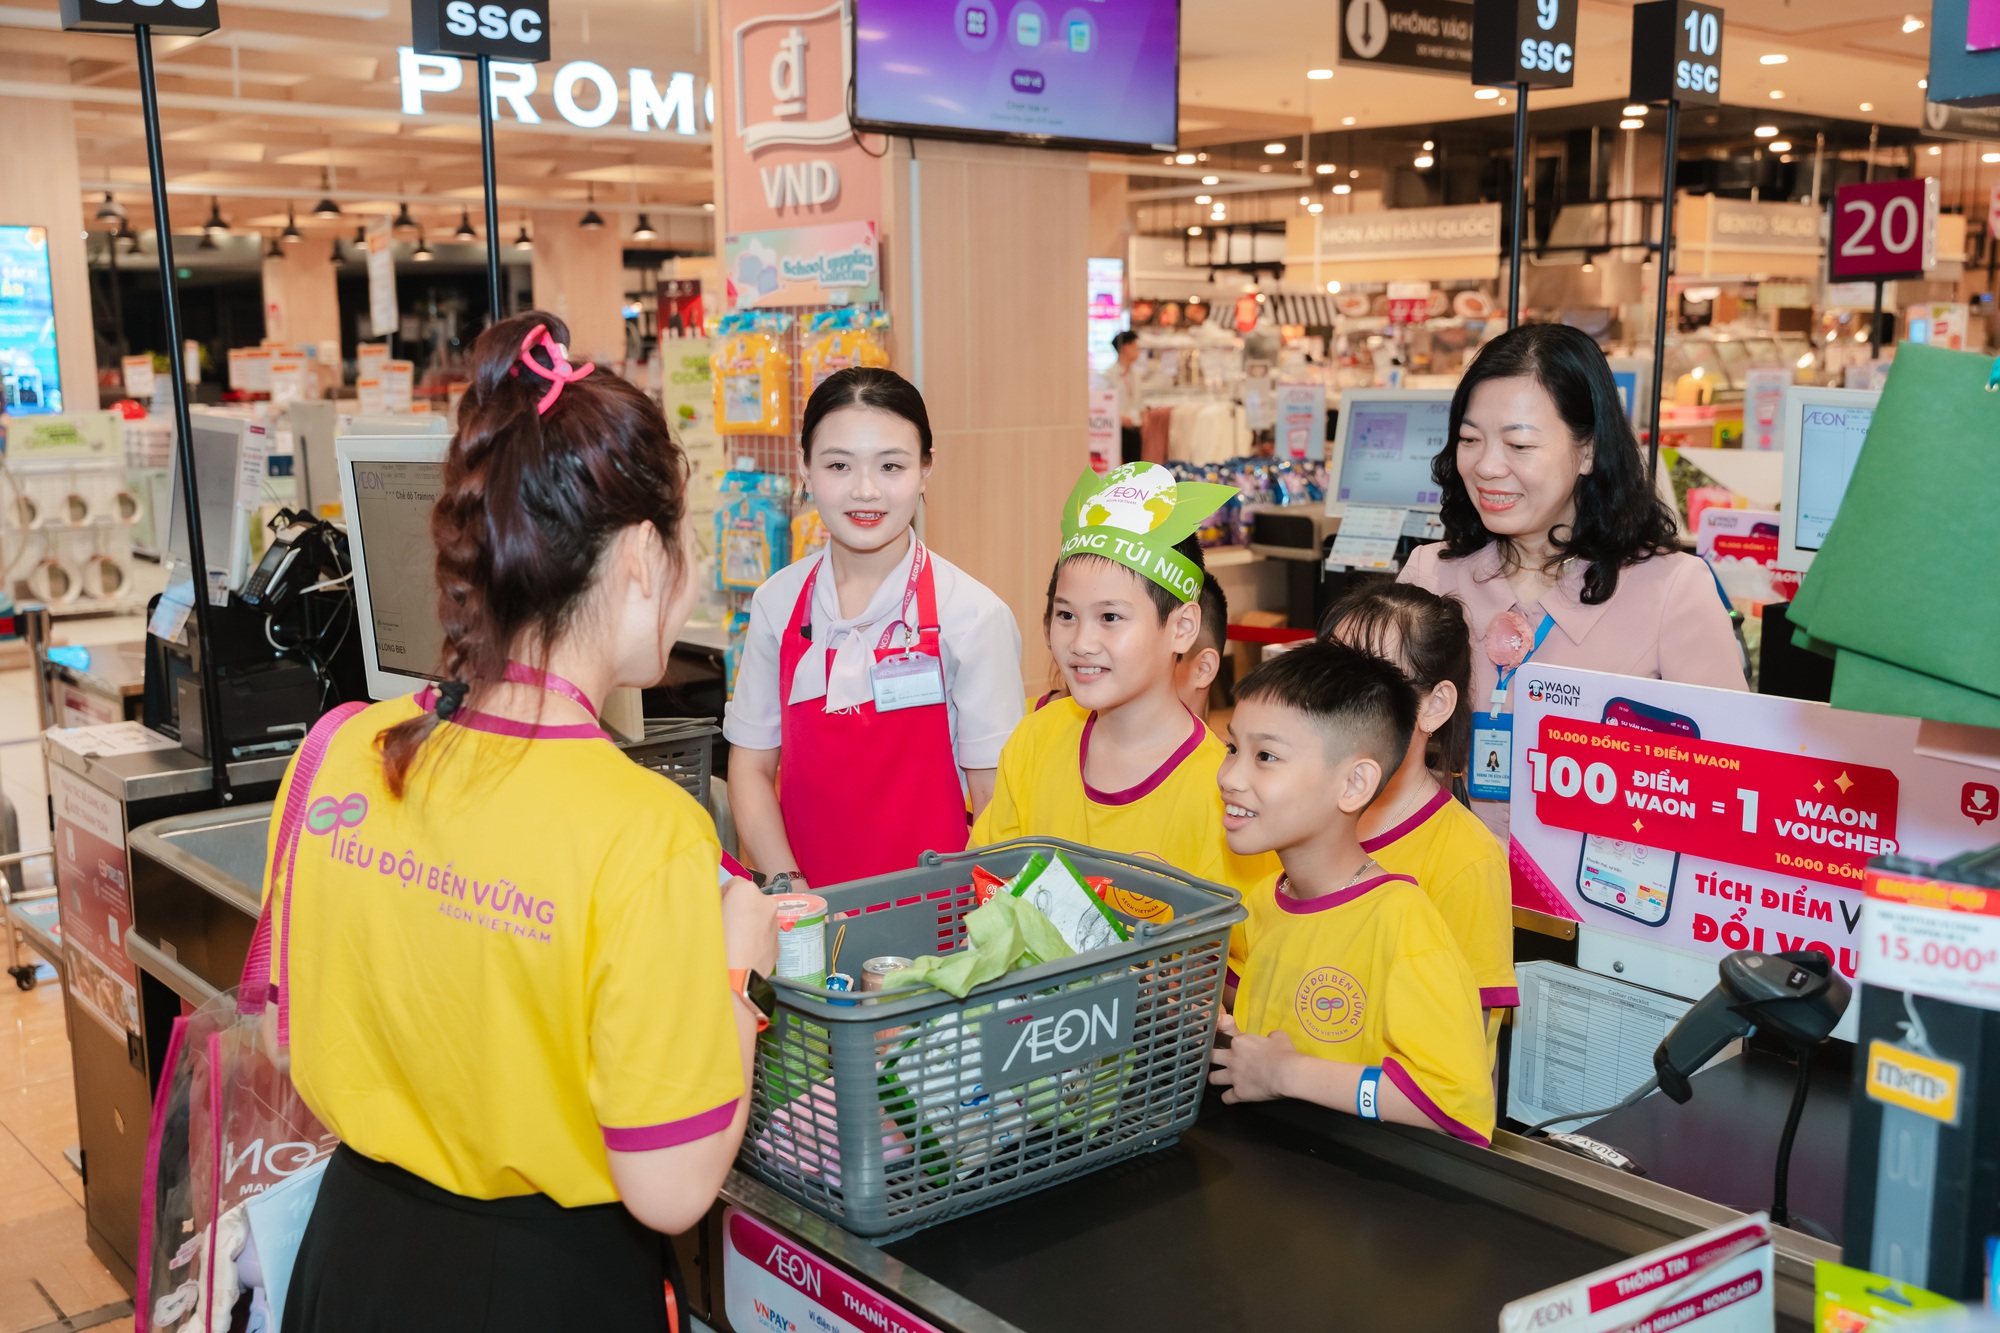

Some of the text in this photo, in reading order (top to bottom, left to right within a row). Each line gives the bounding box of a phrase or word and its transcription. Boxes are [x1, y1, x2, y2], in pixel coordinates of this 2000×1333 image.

[446, 1, 542, 43] SSC
[1684, 11, 1718, 55] 10
[1520, 38, 1572, 73] SSC
[398, 46, 714, 135] PROM
[1676, 60, 1720, 94] SSC
[760, 160, 841, 208] VND
[1841, 196, 1919, 256] 20
[414, 492, 435, 503] Training
[1061, 533, 1108, 555] HÔNG
[1114, 538, 1151, 566] TÚI
[382, 643, 395, 652] LONG
[1545, 681, 1580, 696] WAON
[1545, 693, 1580, 707] POINT
[1548, 728, 1588, 744] 10.000
[1591, 735, 1630, 752] ĐỒNG
[1645, 745, 1651, 755] 1
[1653, 745, 1689, 762] ĐIỂM
[1693, 753, 1740, 770] WAON
[1528, 751, 1617, 804] 100
[1632, 769, 1688, 795] ĐIỂM
[1625, 790, 1695, 819] WAON
[1737, 788, 1759, 833] 1
[1795, 798, 1877, 830] WAON
[1774, 818, 1897, 856] VOUCHER
[1775, 852, 1823, 871] 10.000
[379, 849, 424, 888] ĐỘI
[473, 878, 555, 925] VỮNG
[1695, 871, 1752, 904] TÍCH
[1761, 885, 1833, 922] ĐIỂM
[438, 901, 552, 944] AEON VIETNAM
[1122, 897, 1159, 914] AEON VIETNAM
[1693, 907, 1764, 953] ĐỔI
[1608, 989, 1650, 1006] Cashier checklist
[1305, 1018, 1349, 1037] AEON VIETNAM
[1363, 1091, 1371, 1107] 07
[1616, 1263, 1665, 1296] THÔNG
[1666, 1256, 1689, 1275] TIN
[754, 1298, 789, 1331] VNPAY
[816, 1313, 829, 1328] điện
[842, 1291, 888, 1327] THANH
[1653, 1304, 1696, 1332] NHANH
[1703, 1277, 1758, 1312] NONCASH
